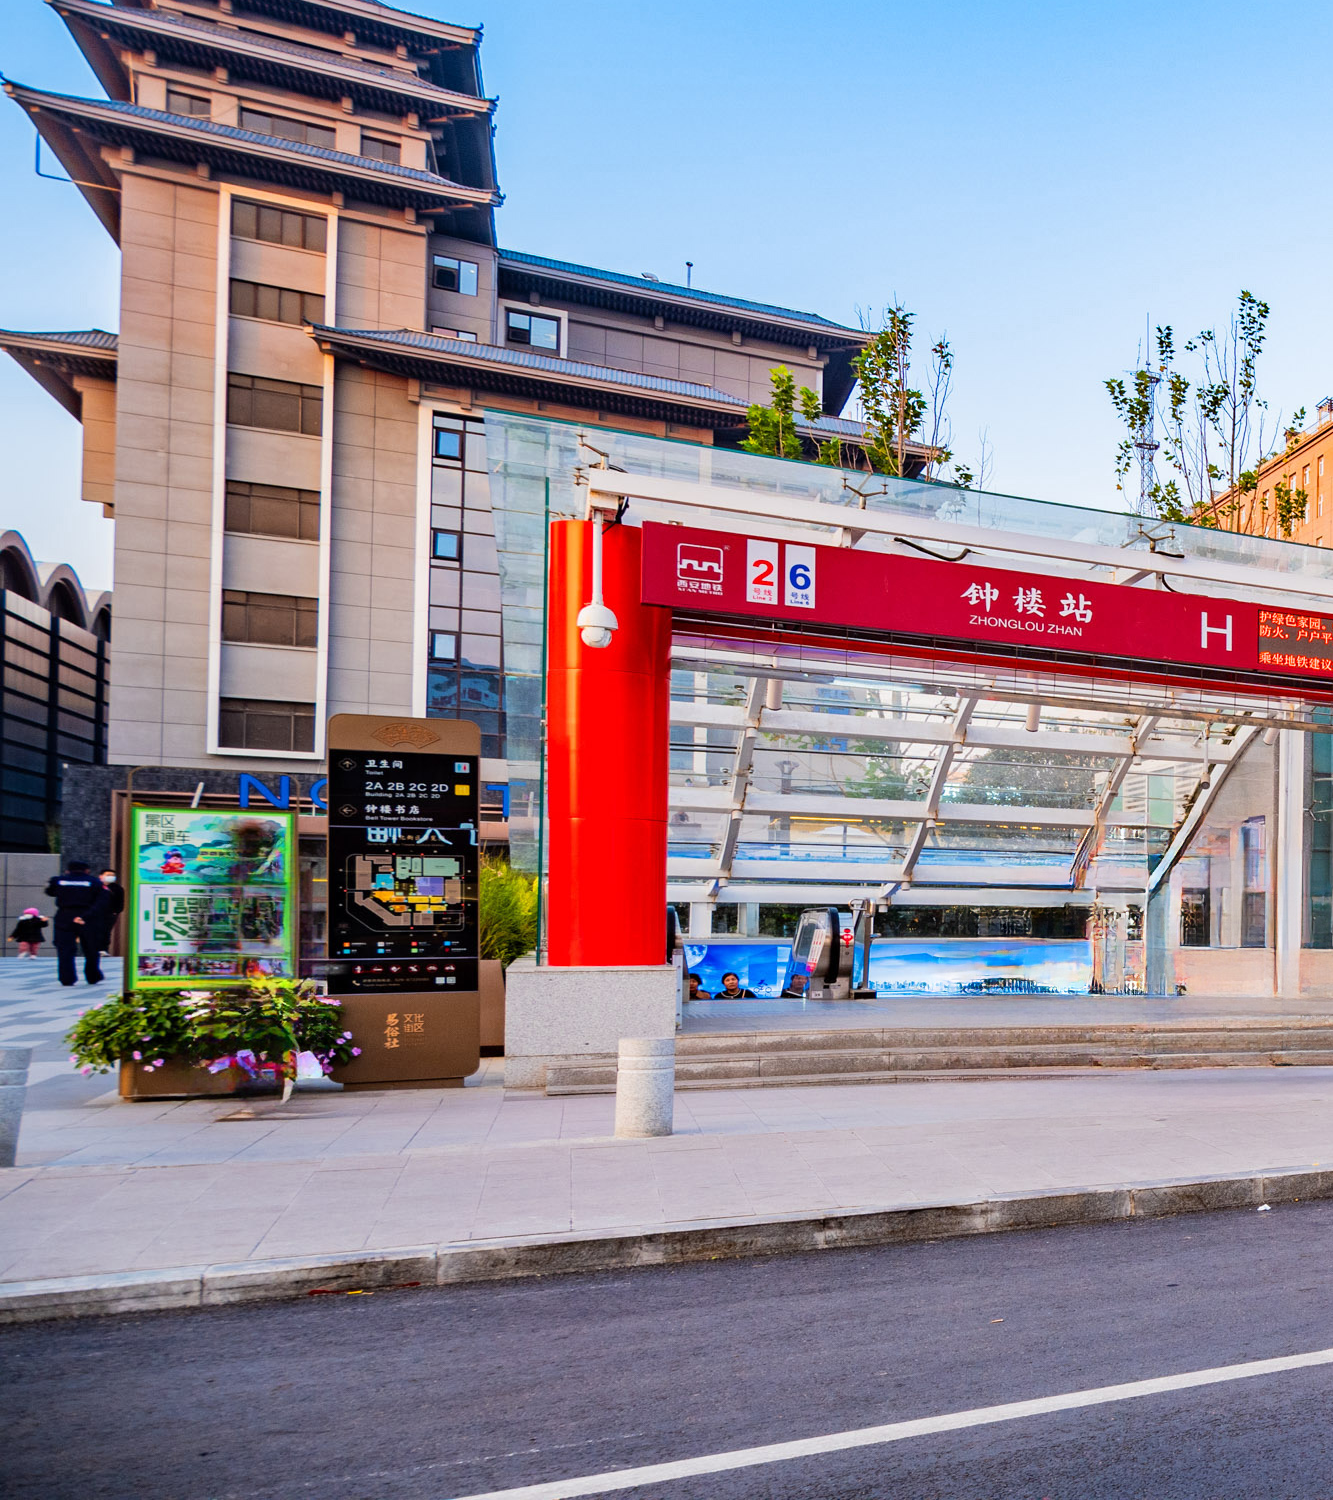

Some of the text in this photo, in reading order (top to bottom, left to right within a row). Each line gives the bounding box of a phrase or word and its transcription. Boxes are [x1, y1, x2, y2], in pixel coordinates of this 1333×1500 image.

[752, 559, 774, 586] 2
[789, 564, 811, 590] 6
[677, 580, 723, 592] 西安地铁
[753, 588, 772, 596] 号线
[791, 592, 809, 600] 号线
[960, 581, 1093, 623] 钟楼站
[969, 615, 1083, 637] ZHONGLOU ZHAN
[1201, 612, 1233, 651] H
[365, 759, 403, 769] 卫生间
[365, 781, 449, 792] 2A 2B 2C 2D
[365, 791, 392, 799] Building
[365, 804, 420, 815] 钟楼书店
[145, 813, 175, 828] 景区
[145, 830, 190, 843] 直通车
[403, 1013, 425, 1023] 文化
[384, 1012, 400, 1049] 易俗社
[403, 1022, 425, 1033] 街区
